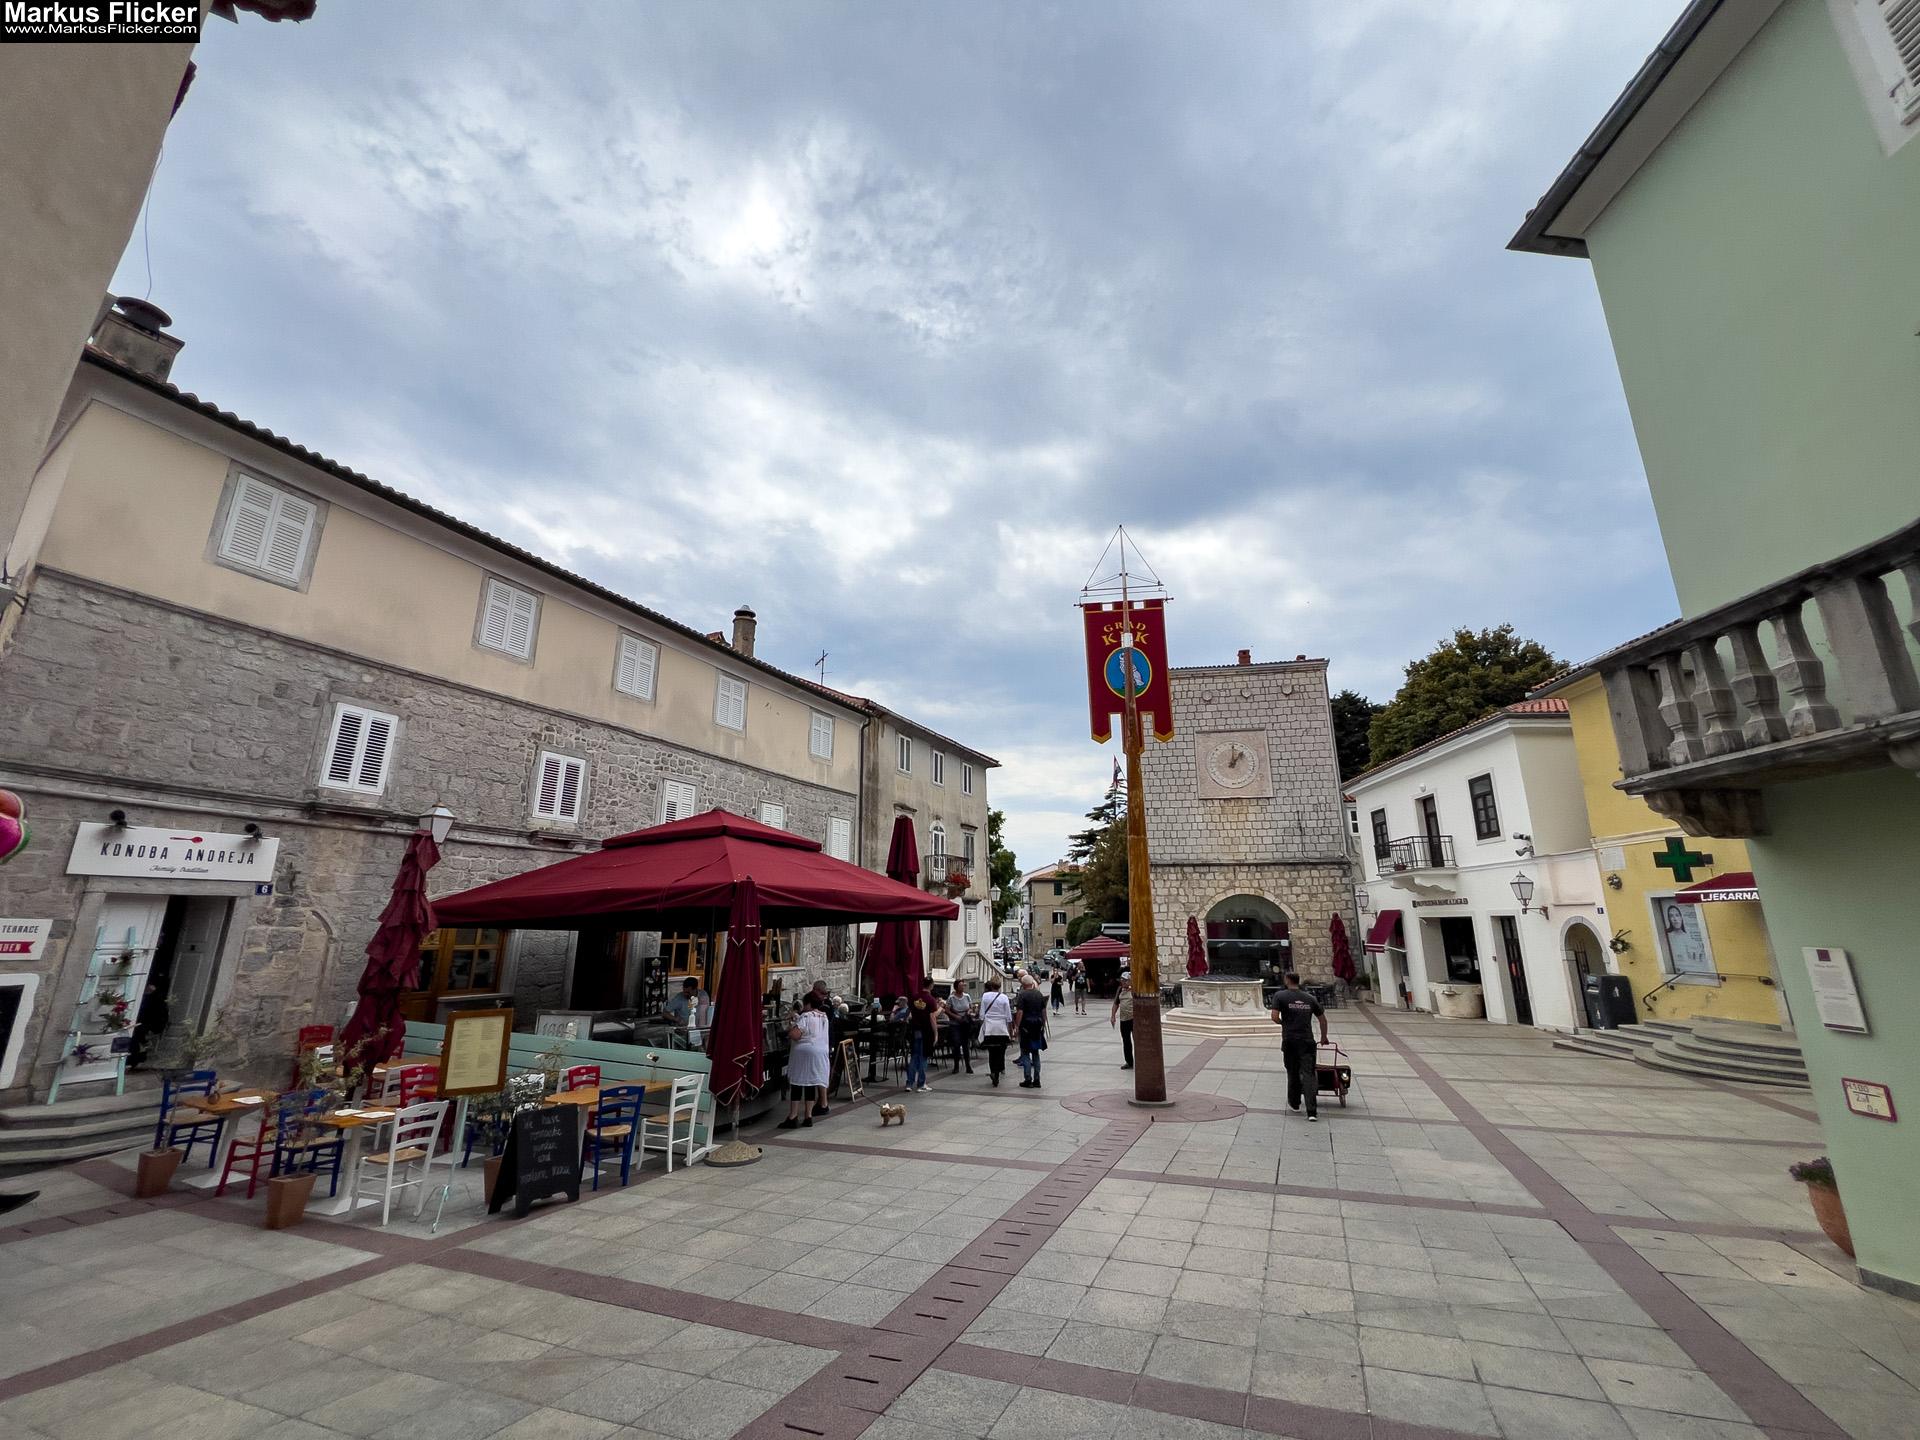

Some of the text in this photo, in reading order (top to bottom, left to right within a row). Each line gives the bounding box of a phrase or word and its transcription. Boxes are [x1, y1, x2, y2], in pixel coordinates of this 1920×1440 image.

[1101, 631, 1150, 646] KK
[100, 842, 255, 865] KONOBA ANDREJA
[149, 864, 177, 874] Family
[261, 885, 268, 894] 6
[1700, 892, 1760, 902] LJEKARNA
[2, 925, 40, 933] TERRACE
